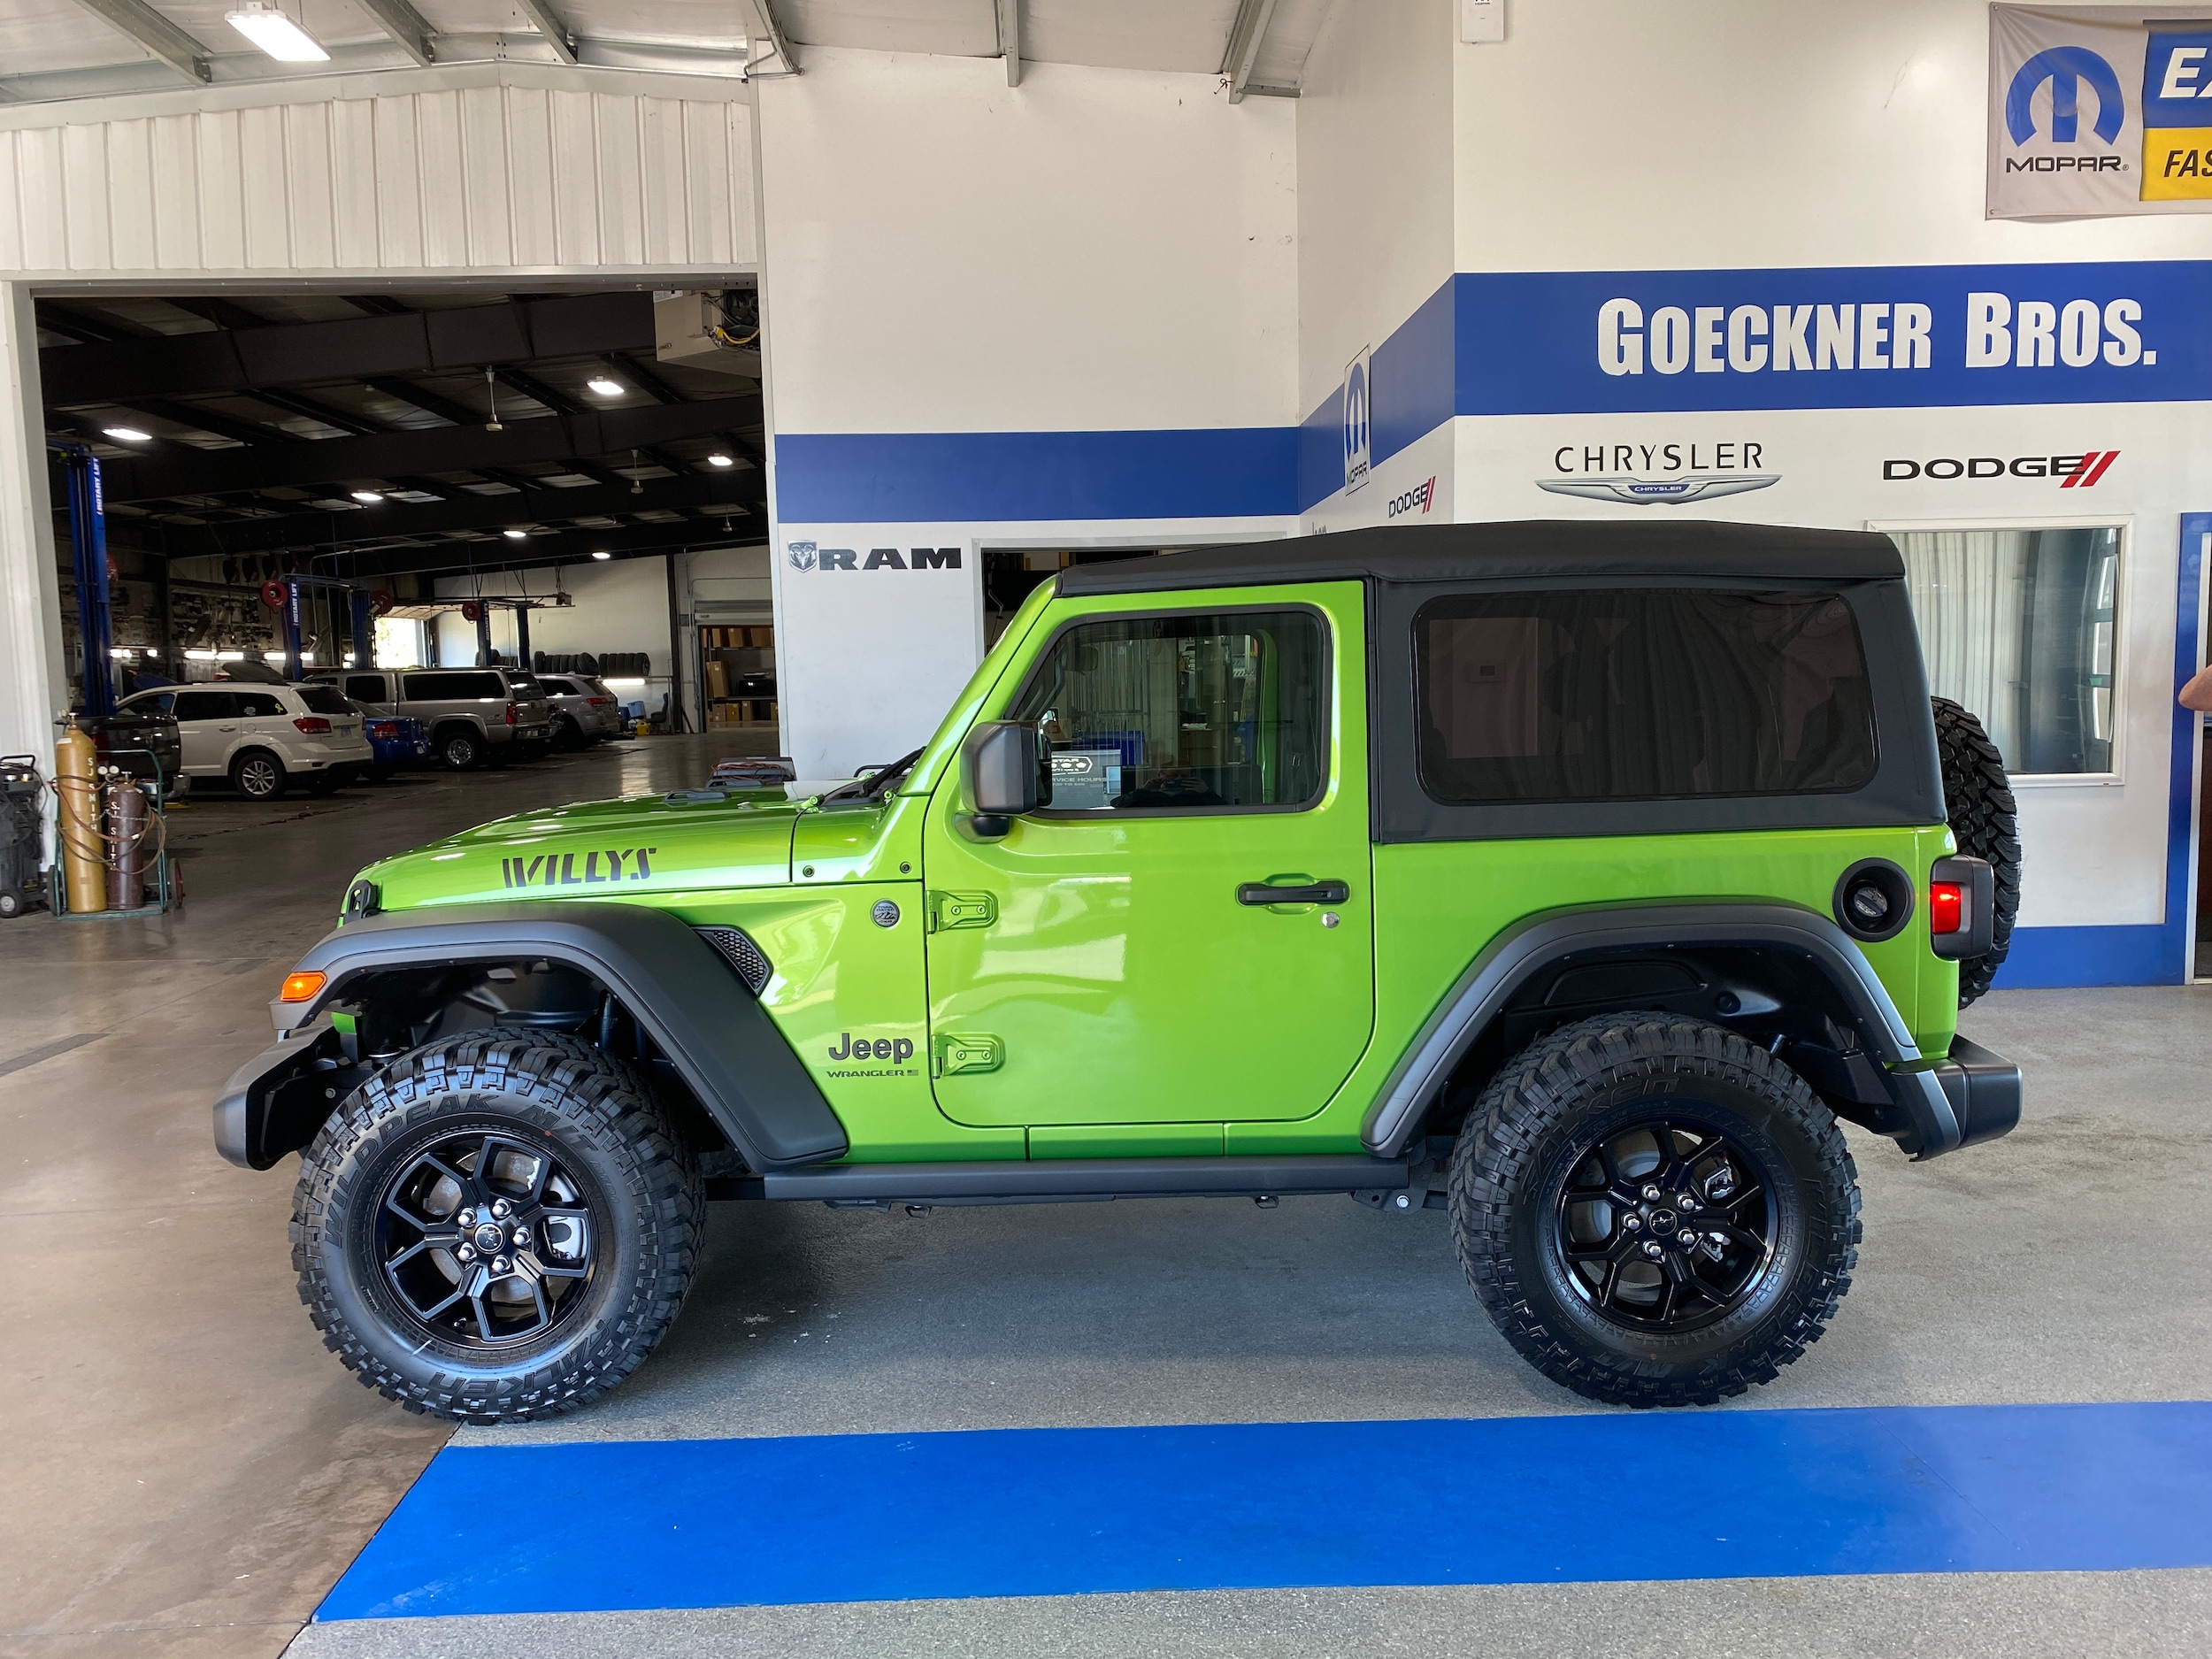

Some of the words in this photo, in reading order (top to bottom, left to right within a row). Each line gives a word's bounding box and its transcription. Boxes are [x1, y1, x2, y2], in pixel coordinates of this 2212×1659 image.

[1597, 297, 1932, 376] GOECKNER
[1965, 292, 2156, 368] BROS.
[1555, 442, 1763, 472] CHRYSLER
[1883, 455, 2086, 480] DODGE
[1388, 482, 1430, 518] DODGE
[818, 547, 962, 570] RAM
[502, 847, 657, 888] WILLYS
[828, 1033, 913, 1064] Jeep
[826, 1069, 904, 1078] WRANGLER
[325, 1093, 500, 1248] WILDPEAK
